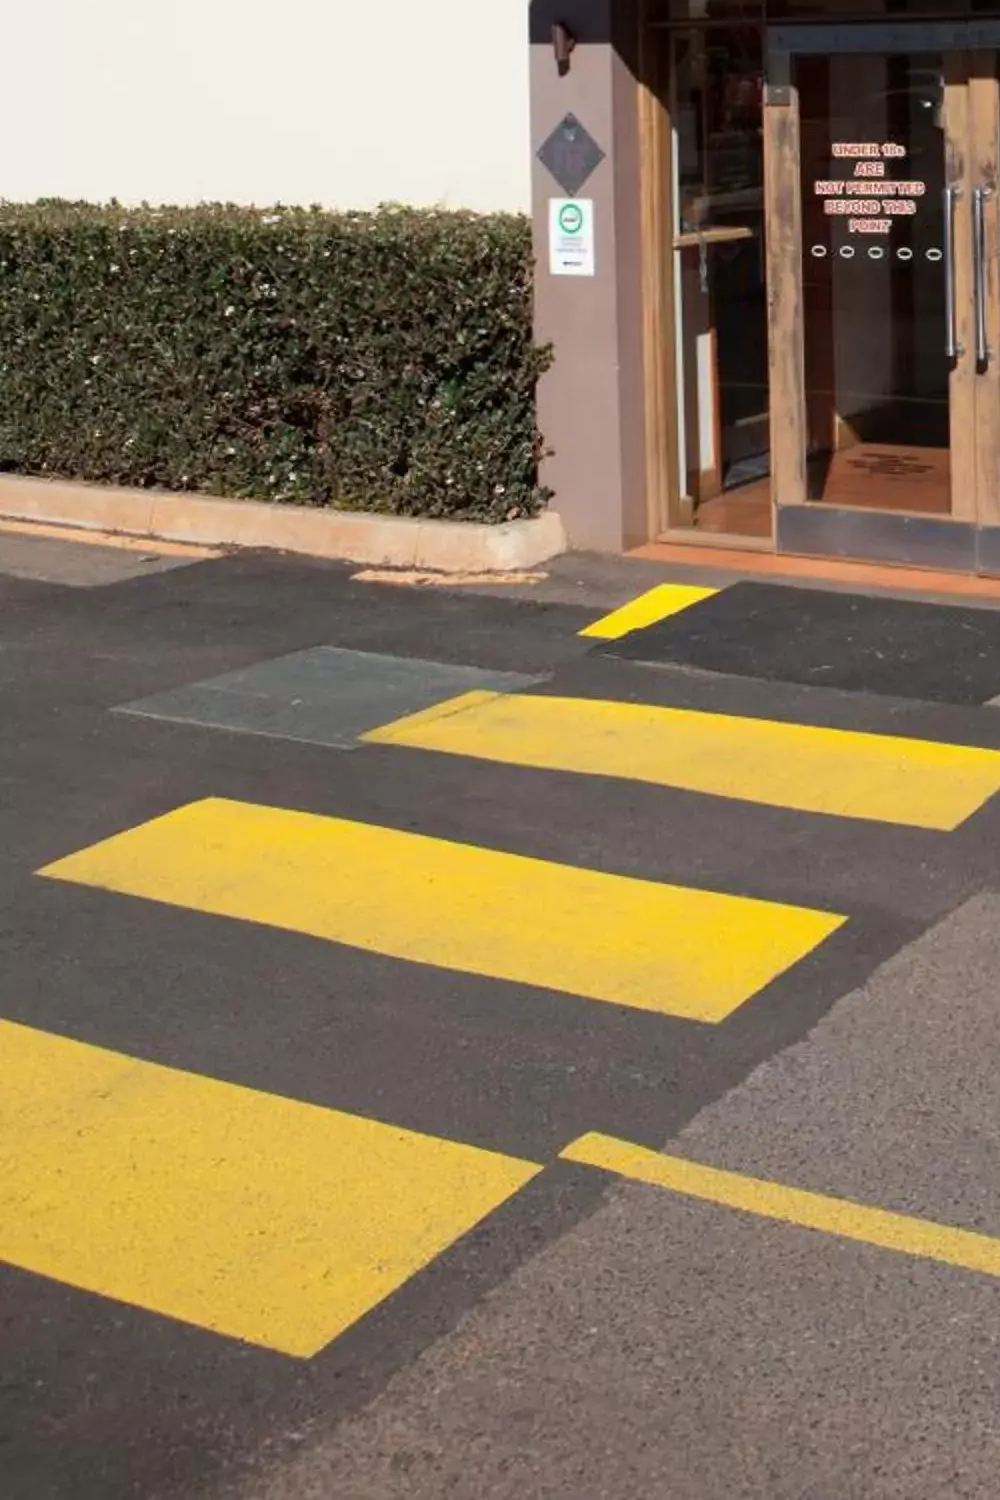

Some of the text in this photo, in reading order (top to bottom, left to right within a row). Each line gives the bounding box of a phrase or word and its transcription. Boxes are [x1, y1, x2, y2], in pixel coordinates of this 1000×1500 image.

[831, 143, 880, 157] UNDER
[854, 162, 885, 177] ARE
[814, 181, 926, 196] NOT PERMITTED
[824, 199, 917, 214] BEYOND THIS
[848, 219, 892, 233] POINT
